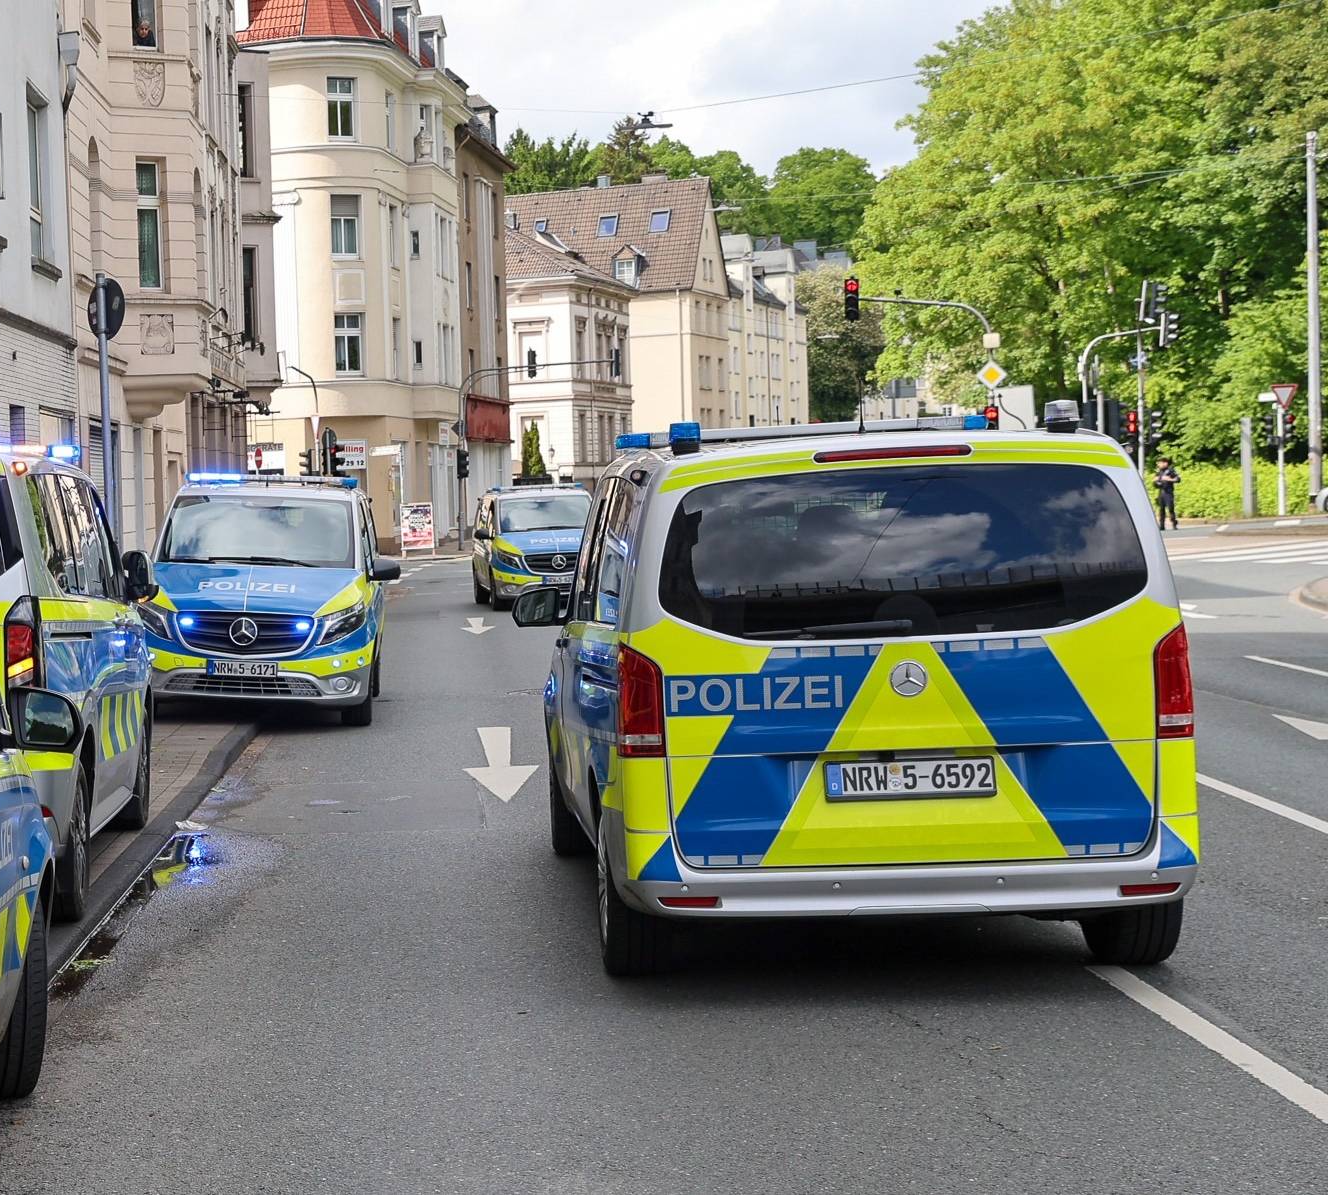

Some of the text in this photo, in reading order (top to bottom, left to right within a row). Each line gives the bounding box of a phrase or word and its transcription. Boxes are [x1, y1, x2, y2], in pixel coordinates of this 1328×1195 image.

[197, 581, 296, 594] POLIZEI
[214, 661, 276, 676] NRW 5-6171
[670, 675, 843, 713] POLIZEI
[831, 763, 993, 792] D NRW 5-6592
